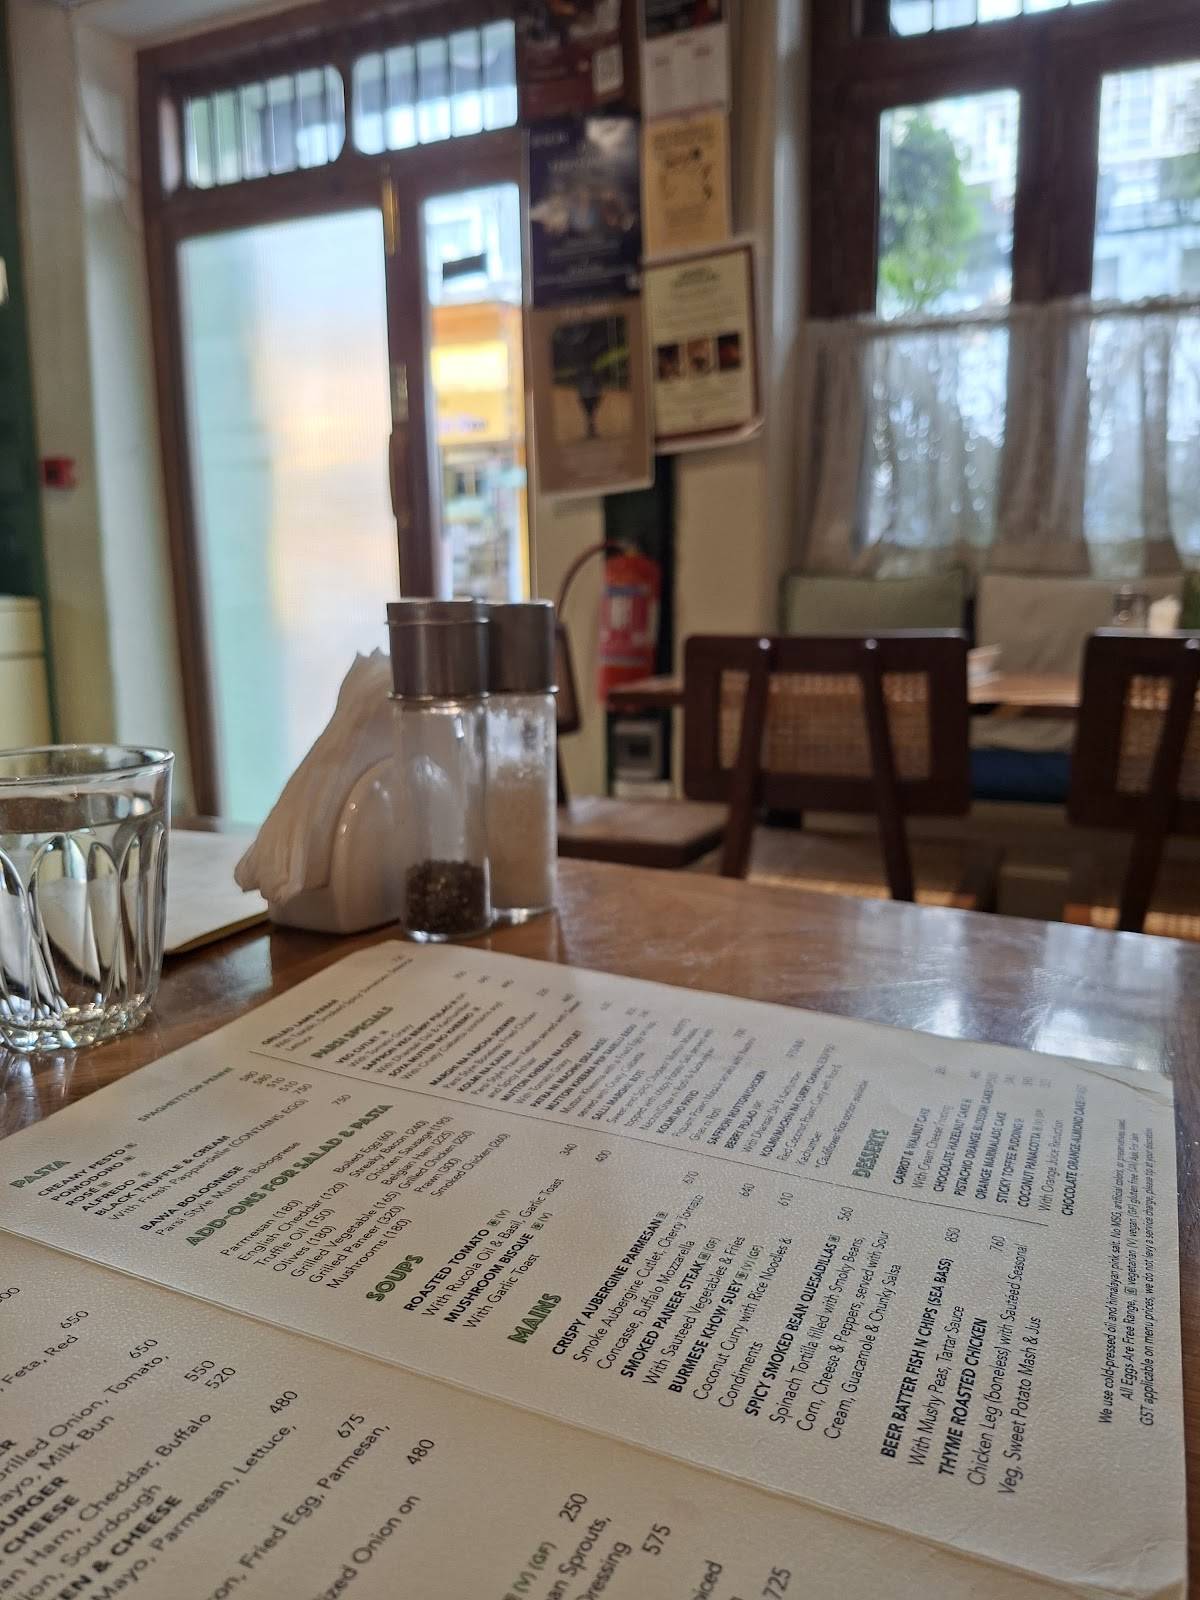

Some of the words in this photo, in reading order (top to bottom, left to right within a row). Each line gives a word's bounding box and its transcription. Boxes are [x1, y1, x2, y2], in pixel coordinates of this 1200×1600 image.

[330, 1093, 352, 1106] 750
[558, 1143, 578, 1157] 340
[850, 1128, 890, 1179] DESSERTS
[8, 1160, 72, 1189] PASTA
[37, 1168, 88, 1197] CREAMY
[87, 1148, 126, 1170] PESTO
[50, 1161, 125, 1202] POMODORO
[93, 1191, 138, 1216] BLACK
[133, 1163, 184, 1192] TRUFFLE
[191, 1135, 231, 1158] CREAM
[538, 1178, 565, 1196] Toast
[81, 1179, 136, 1212] ALFREDO
[139, 1208, 180, 1231] BAWA
[175, 1165, 244, 1208] BOLOGNESE
[185, 1191, 268, 1247] ADD-ONS
[259, 1168, 301, 1192] FOR
[292, 1137, 344, 1170] SALAD
[738, 1182, 756, 1197] 640
[776, 1191, 794, 1207] 610
[236, 1232, 281, 1262] English
[276, 1199, 323, 1232] Cheddar
[319, 1181, 349, 1200] (120)
[518, 1196, 547, 1218] Garlic
[836, 1206, 854, 1222] 560
[219, 1219, 276, 1256] Parmesan
[271, 1199, 304, 1219] (180)
[252, 1241, 293, 1266] Truffle
[288, 1226, 310, 1241] Oil
[304, 1208, 336, 1228] (150)
[289, 1247, 331, 1277] Grilled
[323, 1209, 378, 1248] Vegetable
[489, 1239, 504, 1248] &
[496, 1219, 527, 1240] Basil,
[943, 1226, 961, 1243] 850
[988, 1234, 1006, 1252] 760
[325, 1239, 388, 1289] Mushrooms
[402, 1266, 453, 1312] ROASTED
[447, 1228, 490, 1265] TOMATO
[475, 1246, 497, 1261] Oil
[365, 1254, 424, 1302] SOUPS
[443, 1263, 505, 1323] MUSHROOM
[497, 1232, 535, 1264] BISQUE
[444, 1262, 483, 1292] Rucola
[551, 1318, 586, 1355] CRISPY
[580, 1264, 629, 1319] AUBERGINE
[620, 1218, 663, 1265] PARMESAN
[880, 1264, 902, 1287] Salsa
[933, 1257, 955, 1284] BASS)
[420, 1293, 453, 1316] With
[867, 1286, 897, 1322] Chunky
[926, 1285, 945, 1307] (SEA
[1104, 1270, 1123, 1306] himalayan
[59, 1310, 89, 1329] 650
[506, 1292, 562, 1345] MAINS
[595, 1320, 644, 1370] Concasse,
[631, 1285, 665, 1318] Buffalo
[655, 1240, 696, 1285] Mozzarella
[619, 1329, 660, 1378] SMOKED
[651, 1290, 687, 1330] PANEER
[678, 1259, 706, 1291] STEAK
[917, 1306, 938, 1337] CHIPS
[1103, 1304, 1118, 1322] and
[1122, 1299, 1139, 1325] Range,
[667, 1339, 709, 1393] BURMESE
[699, 1304, 728, 1339] KHOW
[720, 1278, 744, 1305] SUEY
[743, 1380, 772, 1417] SPICY
[761, 1332, 795, 1381] SMOKED
[784, 1302, 810, 1332] BEAN
[799, 1242, 838, 1303] QUESADILLAS
[863, 1324, 881, 1333] &
[964, 1316, 988, 1367] CHICKEN
[1021, 1335, 1039, 1345] &
[1024, 1316, 1042, 1335] Jus
[1103, 1321, 1117, 1333] oil
[1121, 1325, 1136, 1345] Free
[0, 1358, 48, 1384] Feta,
[43, 1333, 79, 1357] Red
[128, 1338, 159, 1359] 650
[913, 1337, 929, 1349] N
[1121, 1345, 1135, 1363] Are
[183, 1359, 216, 1383] 550
[717, 1341, 764, 1408] Condiments
[840, 1334, 877, 1394] Guacamole
[904, 1348, 926, 1375] FISH
[1016, 1346, 1037, 1377] Mash
[1099, 1332, 1120, 1389] cold-pressed
[1119, 1363, 1139, 1386] Eggs
[204, 1366, 237, 1389] 520
[1119, 1386, 1134, 1401] All
[48, 1398, 109, 1438] Onion,
[103, 1355, 170, 1394] Tomato,
[268, 1390, 299, 1414] 480
[890, 1376, 919, 1422] BATTER
[949, 1367, 977, 1427] ROASTED
[1009, 1378, 1033, 1419] Potato
[1102, 1389, 1114, 1407] use
[336, 1413, 365, 1439] 675
[822, 1397, 857, 1440] Cream,
[36, 1441, 81, 1471] Milk
[75, 1415, 115, 1441] Bun
[406, 1438, 435, 1465] 480
[879, 1422, 905, 1459] BEER
[937, 1426, 964, 1476] THYME
[1001, 1419, 1027, 1462] Sweet
[22, 1527, 82, 1567] Ham,
[77, 1459, 161, 1522] Cheddar,
[154, 1413, 212, 1457] Buffalo
[148, 1478, 241, 1551] Parmesan,
[232, 1425, 297, 1475] Lettuce,
[997, 1465, 1025, 1494] Veg,
[237, 1524, 288, 1570] Fried
[280, 1494, 326, 1526] Egg,
[315, 1425, 391, 1490] Parmesan,
[557, 1492, 588, 1523] 250
[4, 1494, 80, 1554] CHEESE
[59, 1484, 162, 1567] Sourdough
[91, 1560, 113, 1574] &
[109, 1495, 182, 1557] CHEESE
[350, 1516, 402, 1565] Onion
[397, 1495, 421, 1515] on
[640, 1523, 672, 1556] 575
[527, 1541, 558, 1571] (GF)
[557, 1517, 612, 1578] Sprouts,
[762, 1566, 792, 1600] 725
